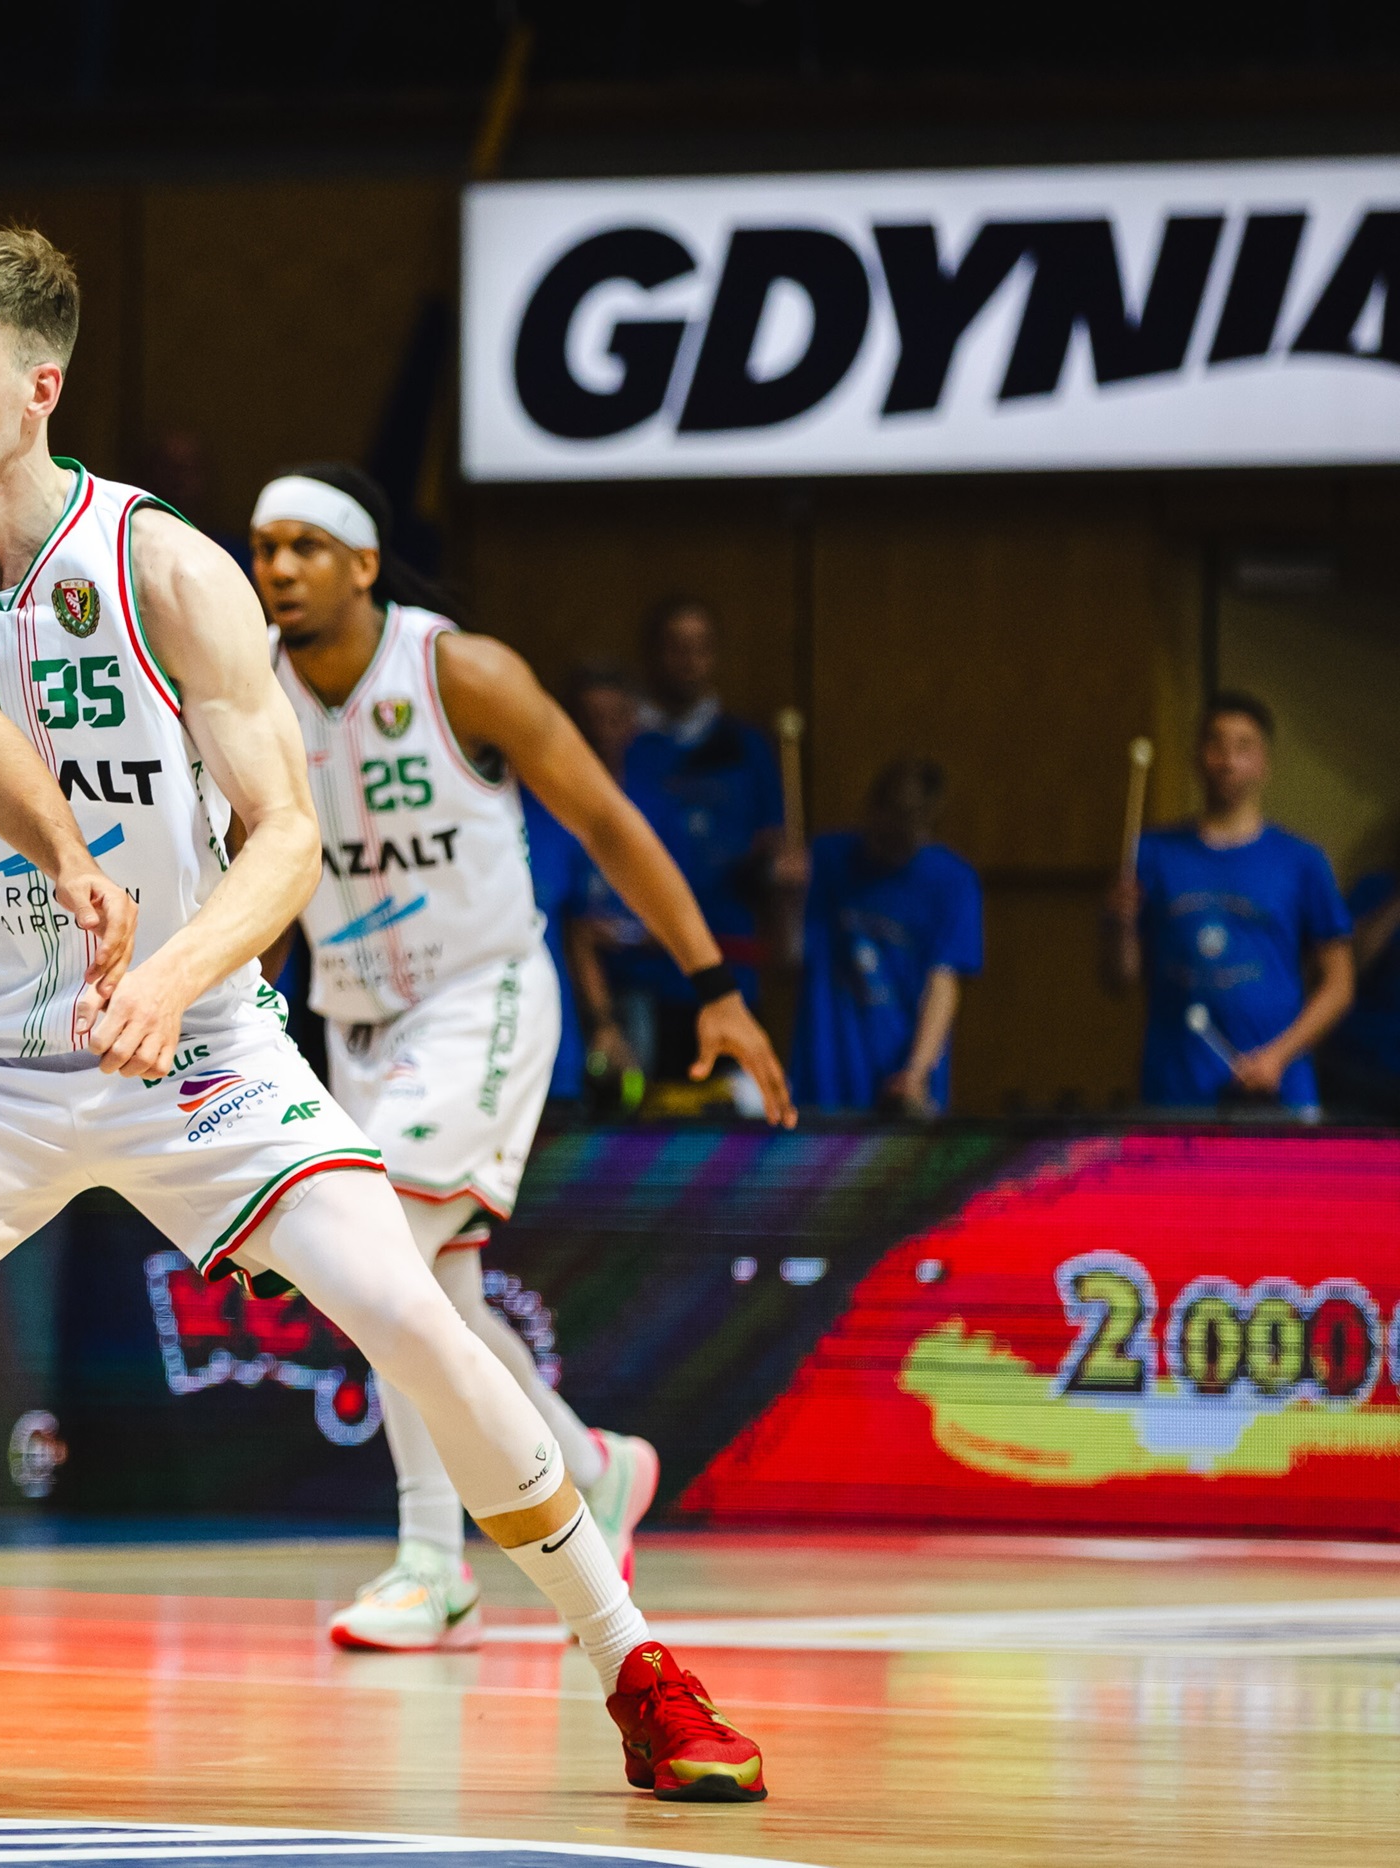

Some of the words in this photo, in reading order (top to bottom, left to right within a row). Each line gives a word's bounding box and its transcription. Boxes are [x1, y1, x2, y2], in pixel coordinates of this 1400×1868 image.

[515, 212, 1400, 439] GDYNIA
[31, 655, 126, 729] 35
[58, 760, 163, 805] ALT
[362, 755, 434, 812] 25
[321, 827, 459, 879] AZALT
[1, 913, 86, 935] AIRP
[187, 1079, 280, 1143] aquapark
